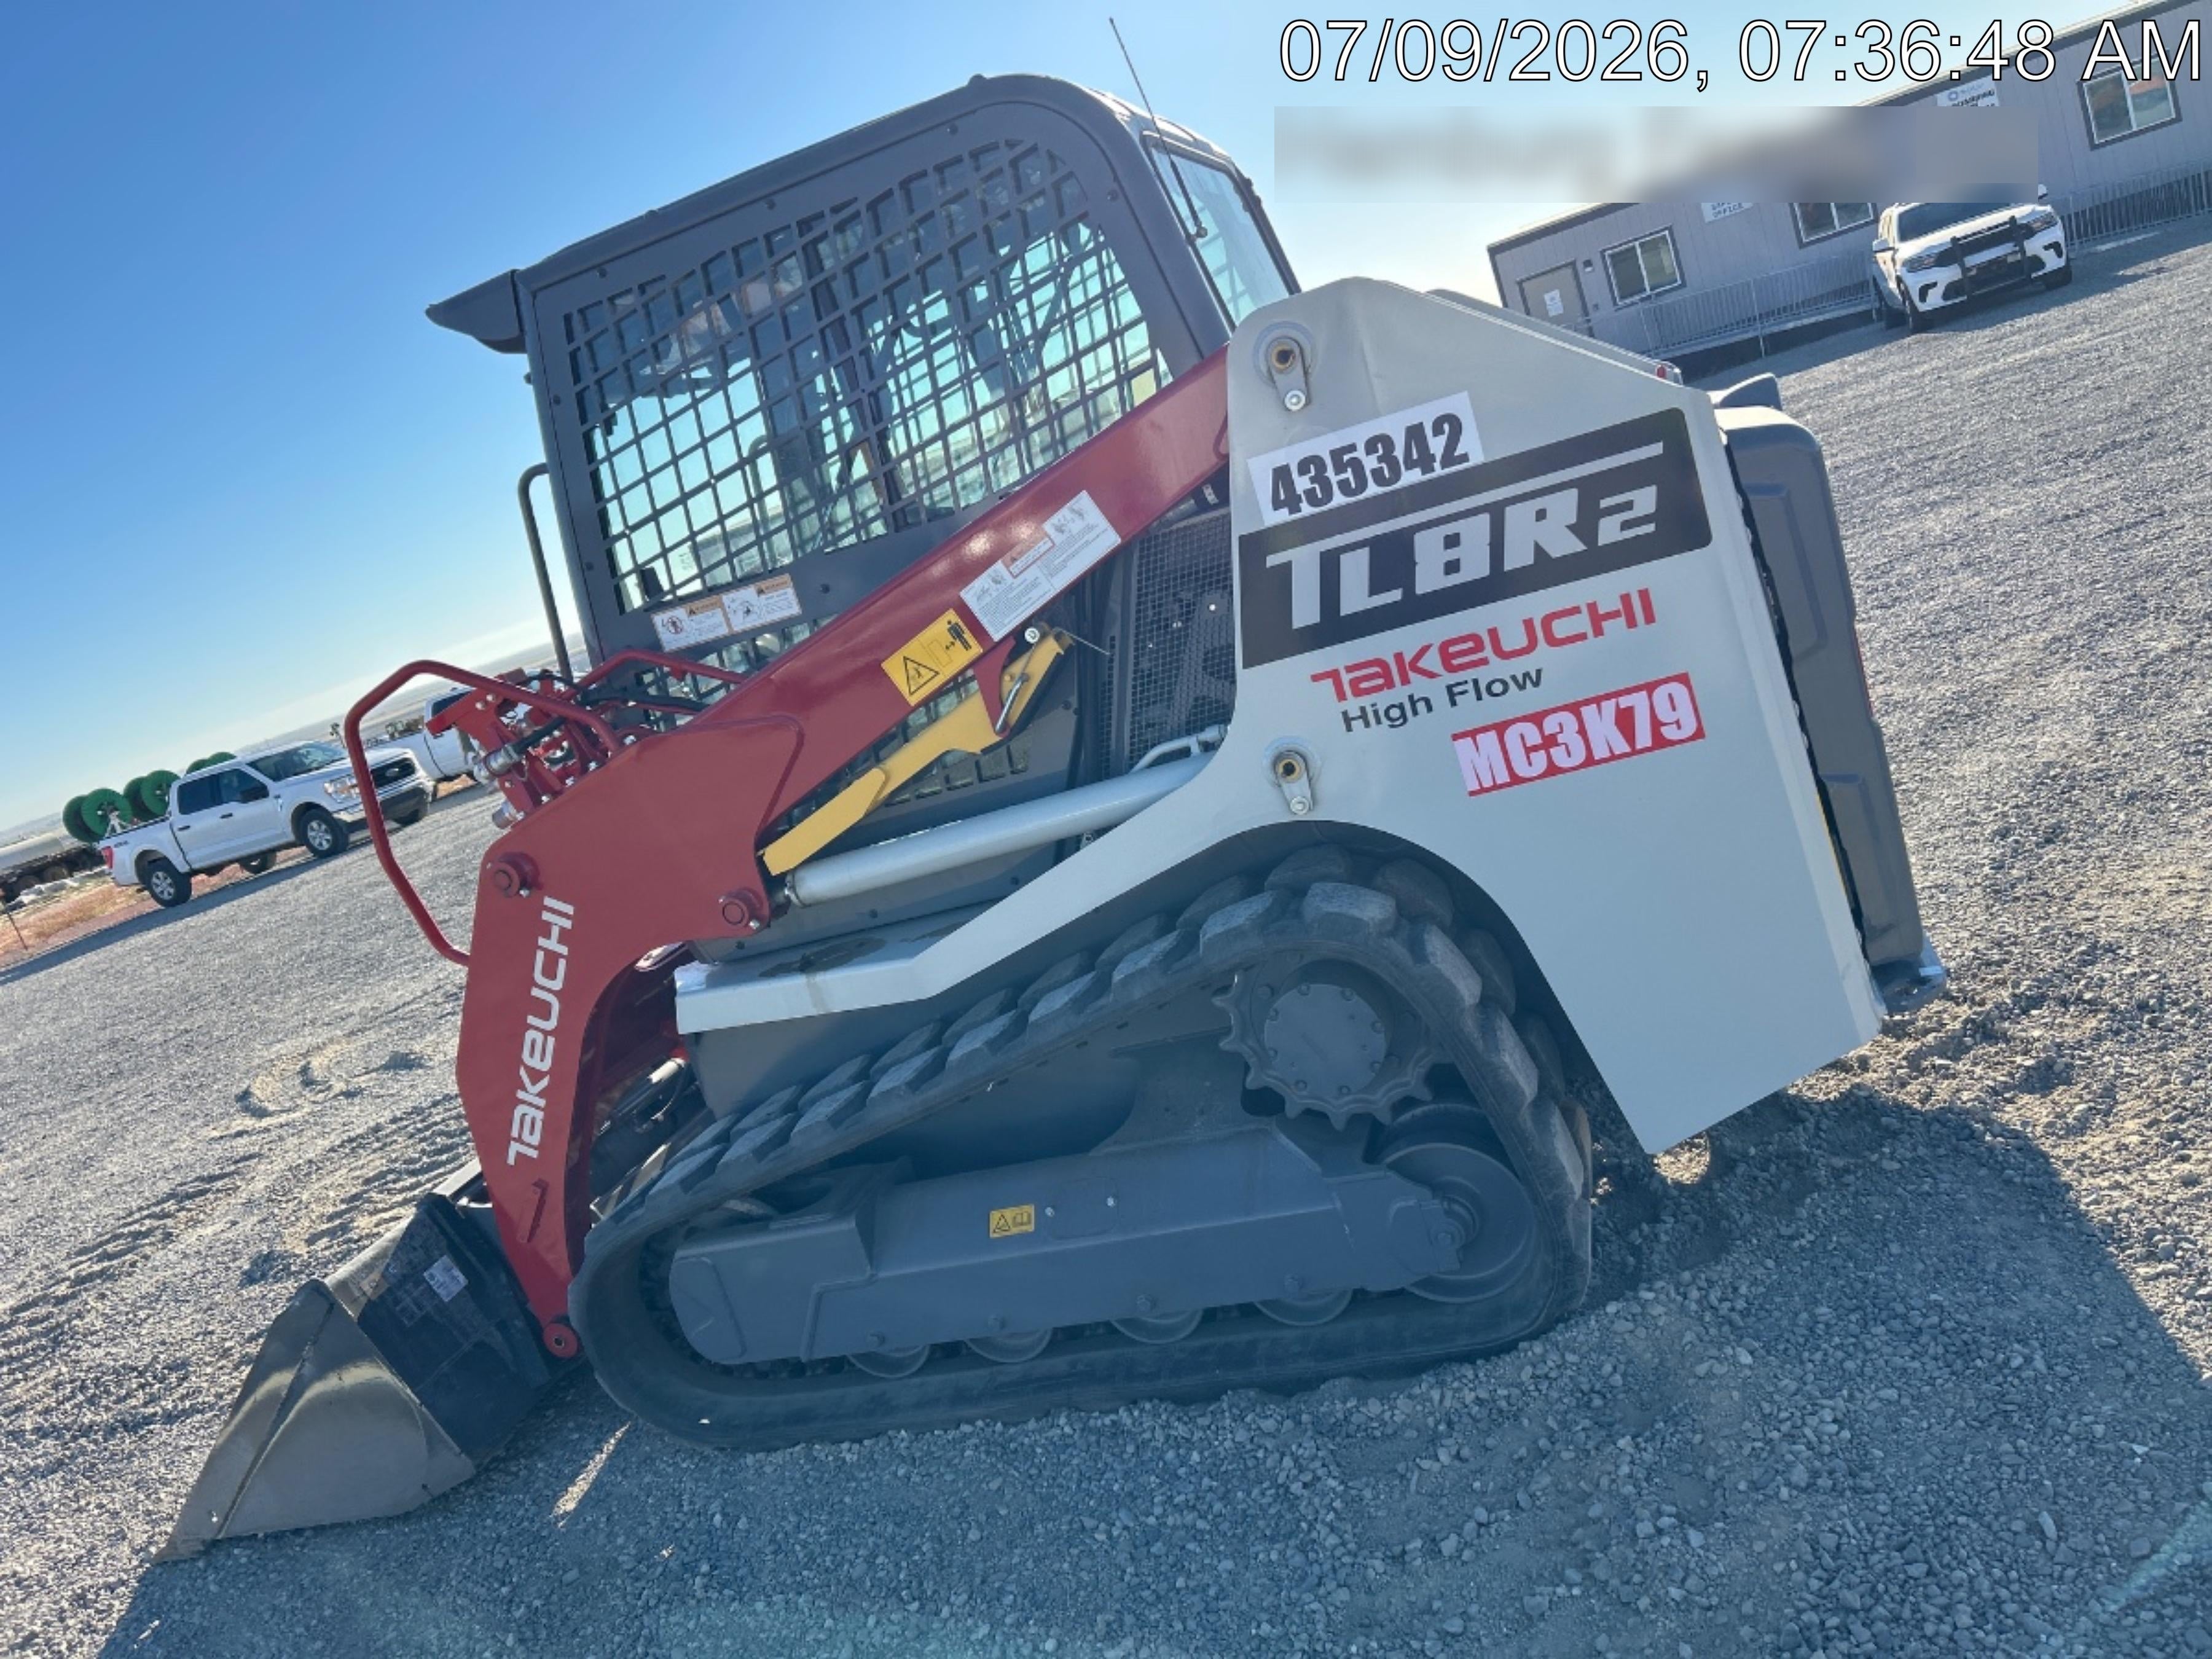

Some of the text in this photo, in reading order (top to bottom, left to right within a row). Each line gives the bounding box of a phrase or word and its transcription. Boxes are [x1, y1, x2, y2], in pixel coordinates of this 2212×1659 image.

[1271, 413, 1470, 516] 435342
[1266, 441, 1664, 630] TL8R2
[1311, 588, 1656, 703] TAKEUCHI
[1341, 668, 1543, 733] High Flow
[1453, 681, 1698, 795] MC3K79
[506, 895, 575, 1166] TAKEUCHI
